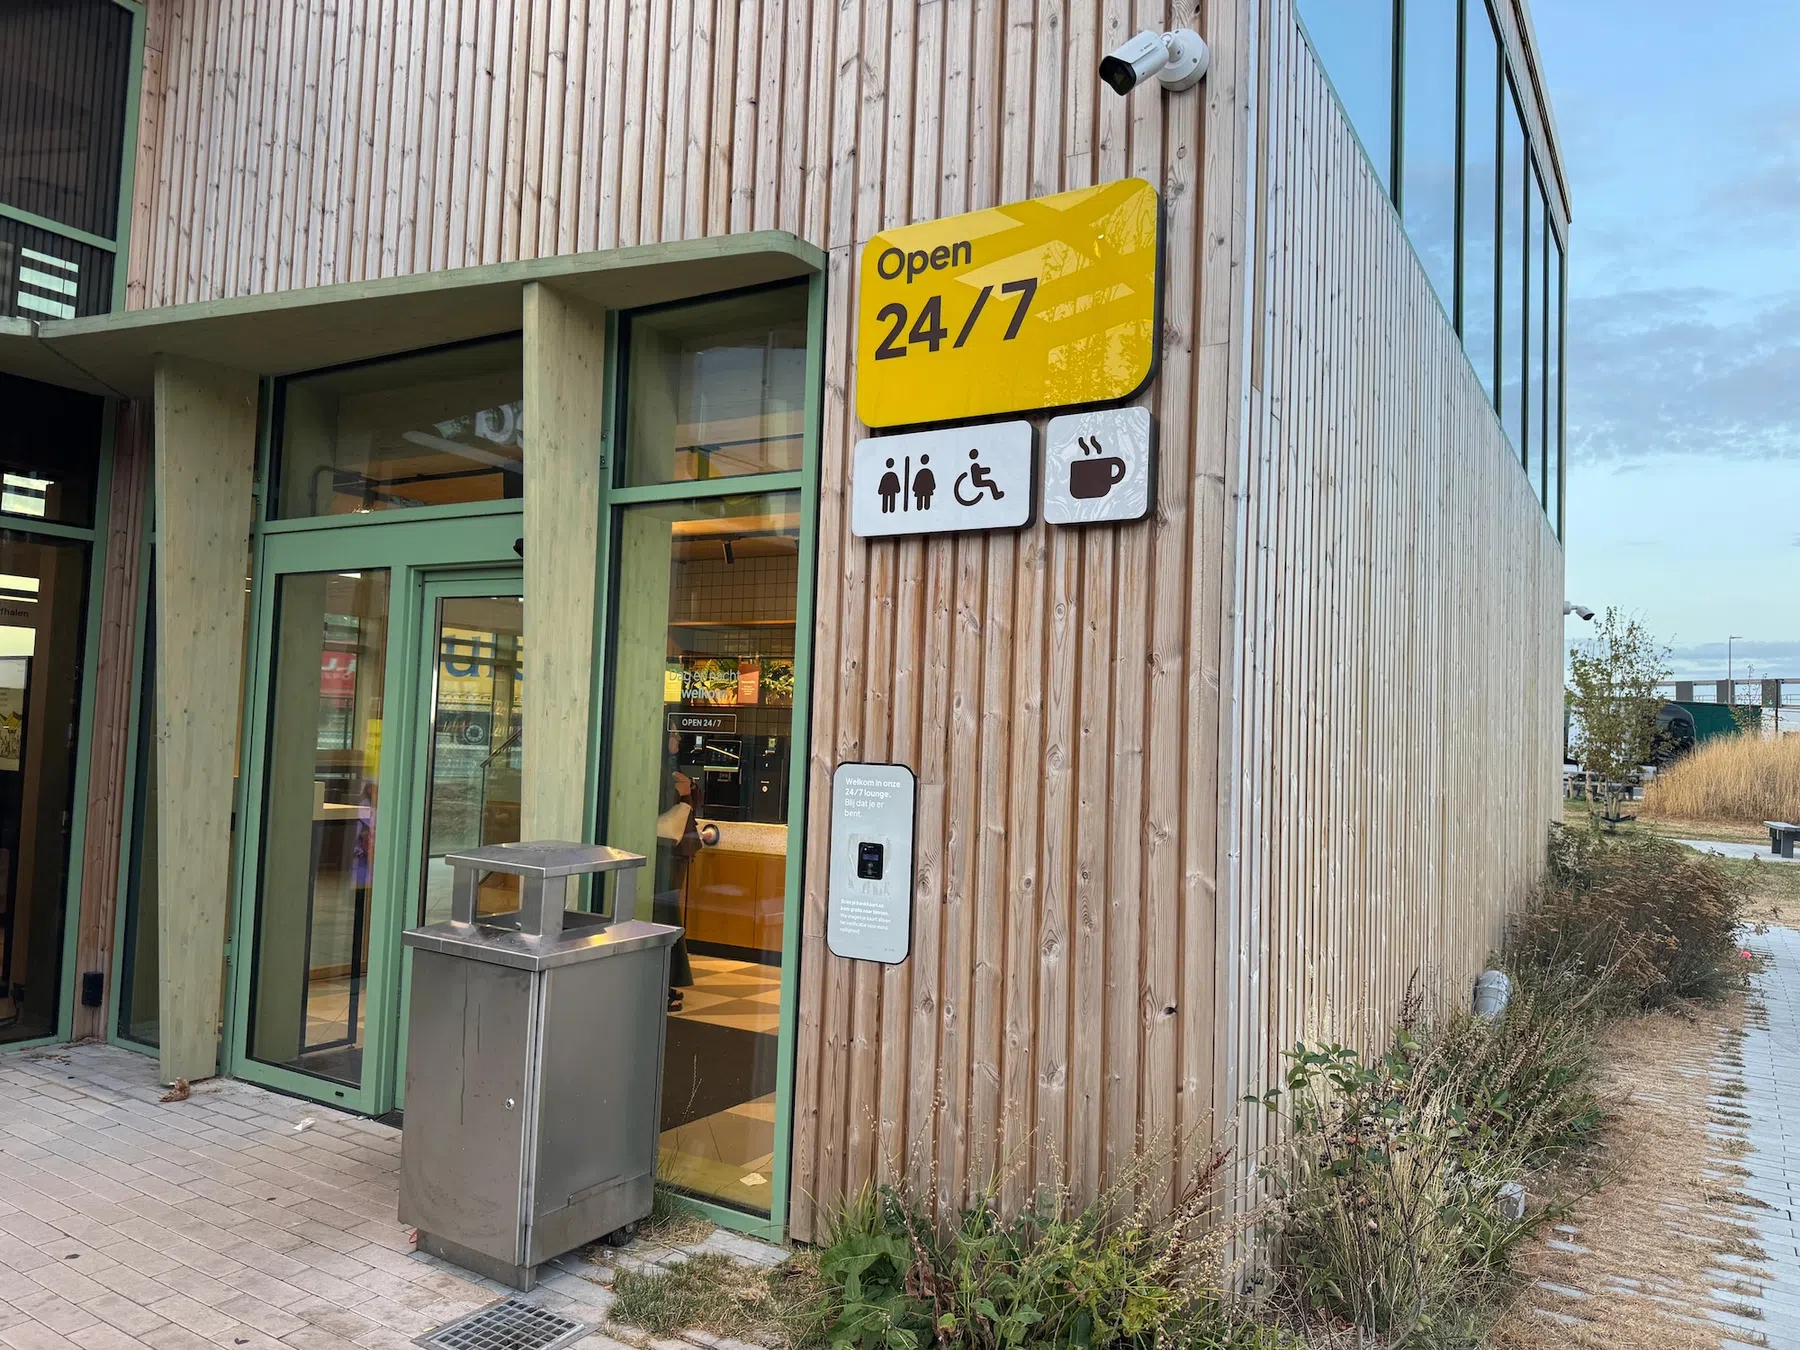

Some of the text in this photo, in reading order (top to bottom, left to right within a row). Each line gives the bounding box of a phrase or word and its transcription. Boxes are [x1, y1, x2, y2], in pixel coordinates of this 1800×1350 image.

[877, 240, 972, 284] Open
[875, 277, 1038, 361] 24/7
[670, 669, 691, 684] Dag
[682, 718, 722, 728] OPEN 24/7
[845, 777, 875, 787] Welkom
[845, 788, 892, 800] 24/7 lounge.
[856, 800, 868, 808] dat
[868, 800, 876, 810] je
